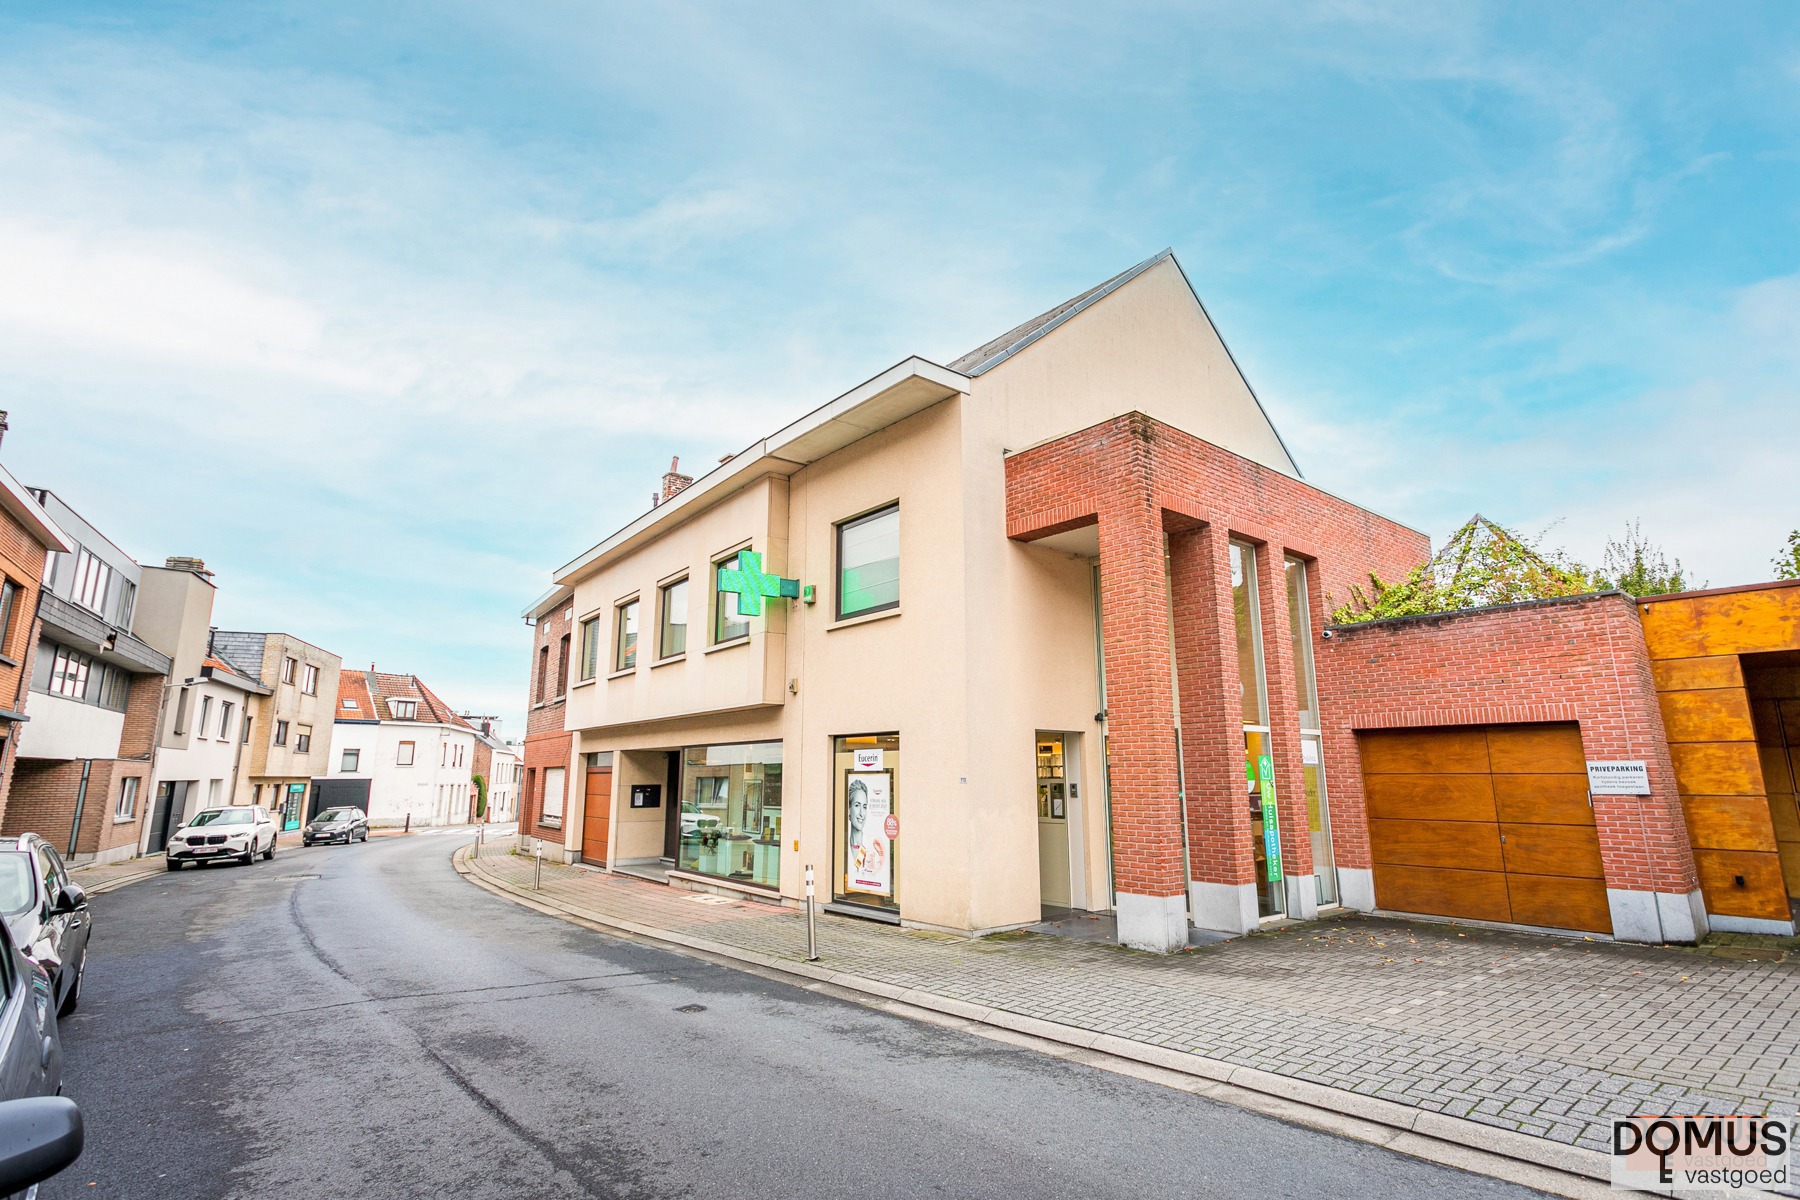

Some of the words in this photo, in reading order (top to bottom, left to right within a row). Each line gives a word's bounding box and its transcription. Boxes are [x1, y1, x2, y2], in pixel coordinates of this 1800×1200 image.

[858, 754, 878, 762] Eucerin
[1266, 783, 1271, 799] Uw
[1267, 801, 1278, 878] Huisapotheker
